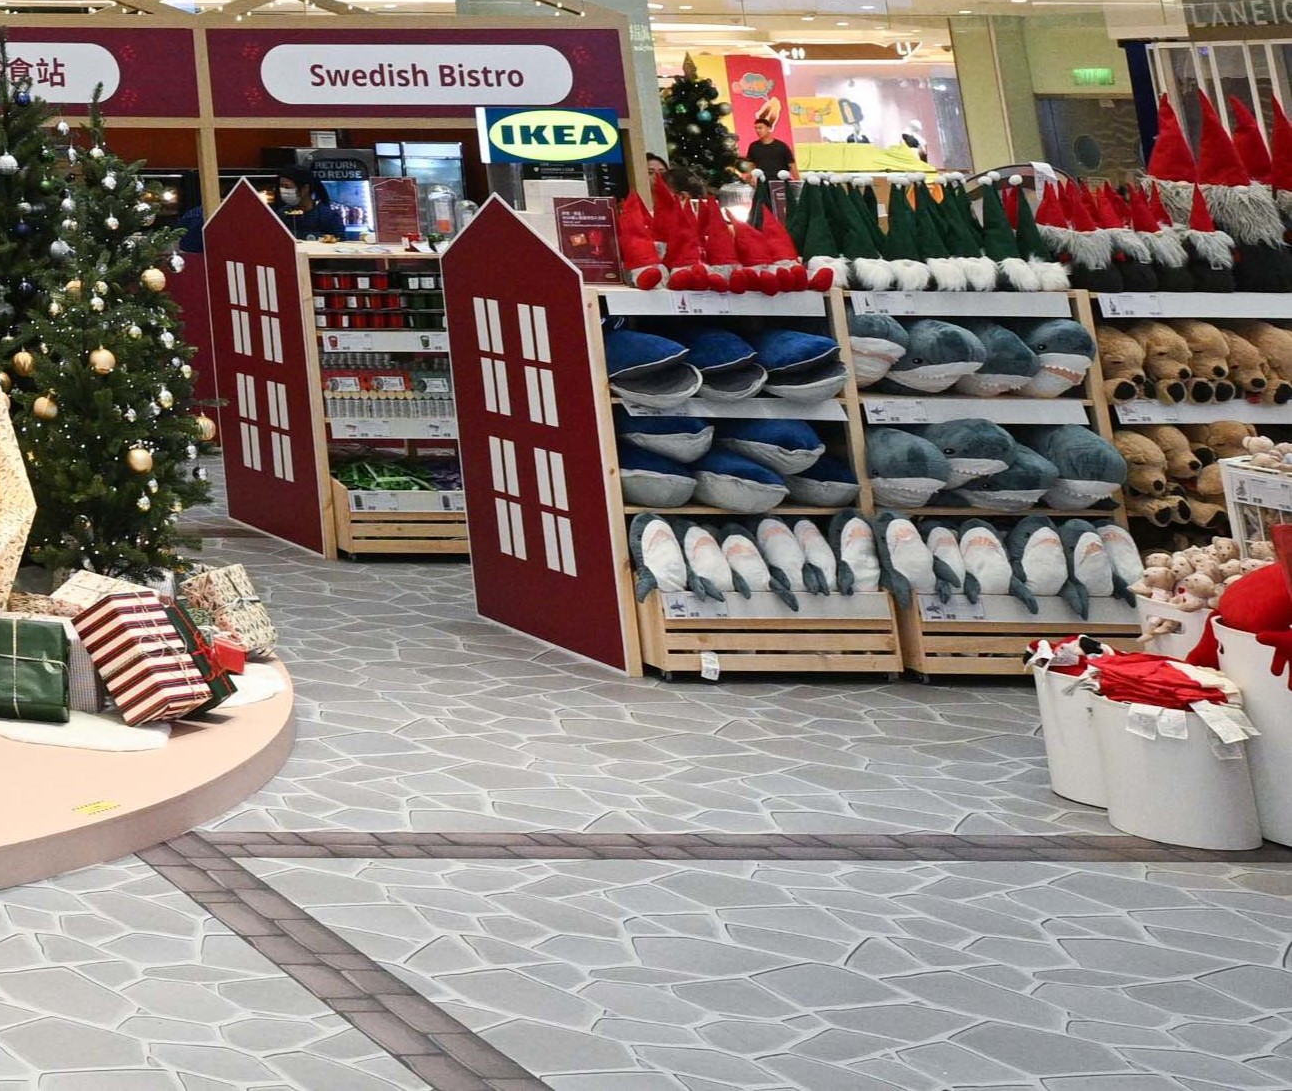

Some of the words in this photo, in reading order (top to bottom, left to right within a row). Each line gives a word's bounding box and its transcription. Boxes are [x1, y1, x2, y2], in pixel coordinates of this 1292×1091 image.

[310, 63, 429, 87] Swedish
[439, 63, 524, 87] Bistro
[501, 125, 609, 145] IKEA
[315, 161, 356, 170] RETURN
[328, 170, 362, 179] REUSE
